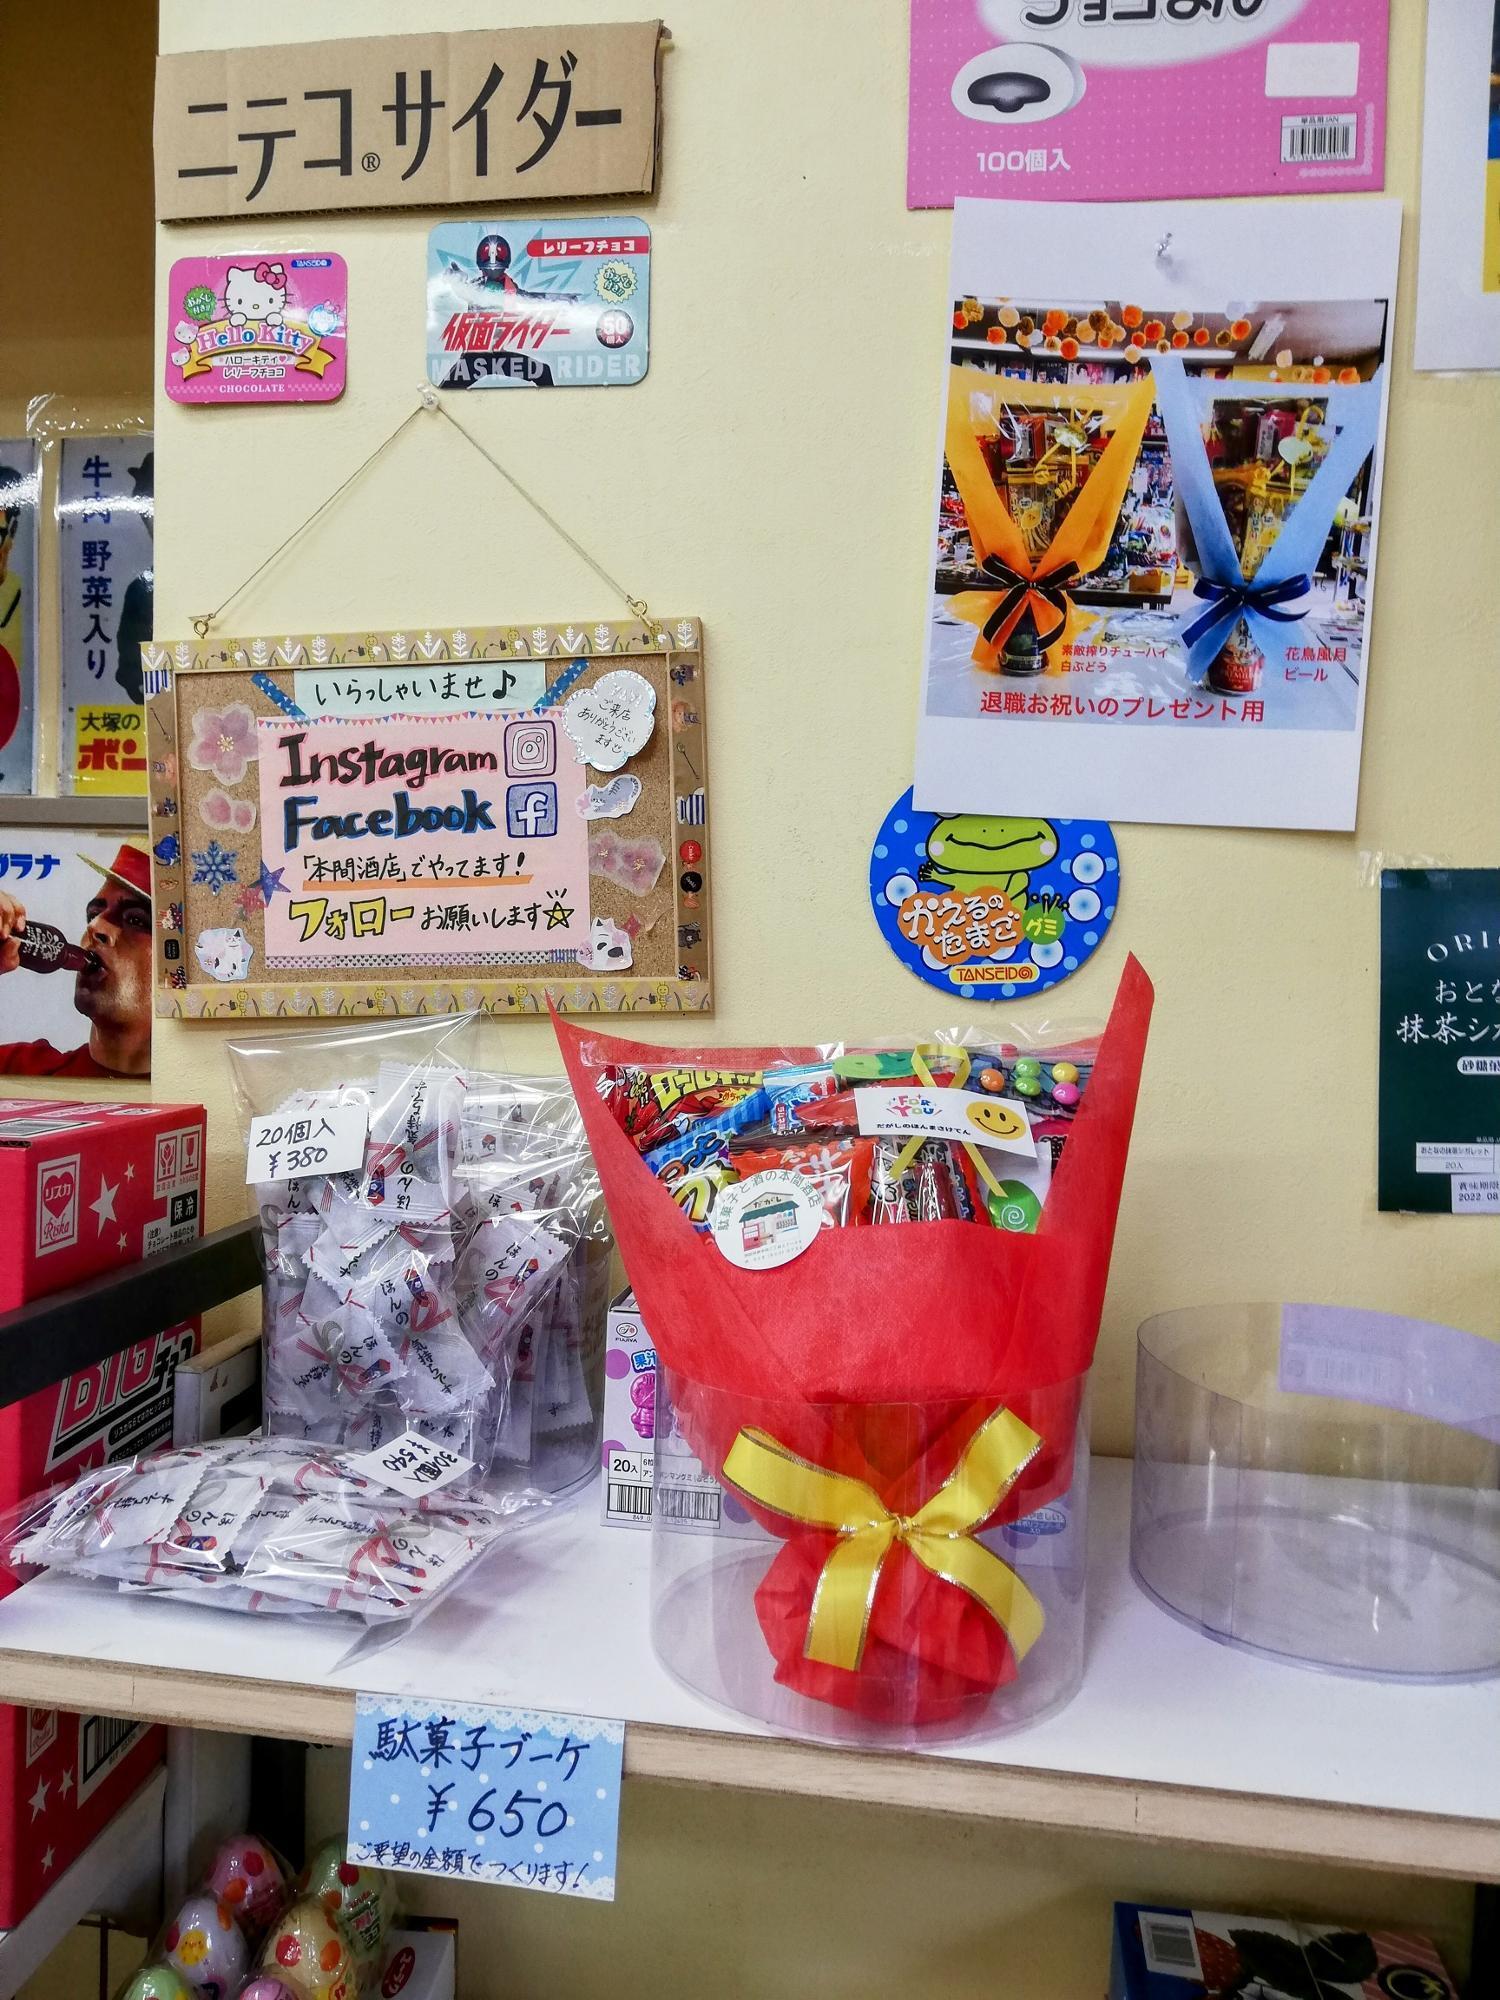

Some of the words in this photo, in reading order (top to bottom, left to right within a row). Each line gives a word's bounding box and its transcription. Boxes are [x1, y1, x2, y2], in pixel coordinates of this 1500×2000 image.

[976, 149, 1071, 173] 100個入
[543, 240, 636, 255] レリーフチョコ
[440, 311, 571, 351] 仮面ライダー
[604, 316, 628, 334] 50
[199, 326, 255, 352] Hello
[259, 323, 313, 354] Kitty
[225, 355, 279, 365] ハローキティ
[431, 357, 546, 382] MASKED
[557, 353, 641, 379] RIDER
[225, 368, 285, 379] レリーフチョコ
[219, 384, 285, 393] CHOCOLATE
[1060, 660, 1107, 673] 白ぶどう
[1284, 646, 1346, 662] 花鳥風月
[1284, 667, 1328, 681] ビール
[979, 691, 1265, 722] 退職お祝いのプレゼント用
[81, 713, 141, 732] 大塚の
[277, 732, 499, 788] Instagram
[283, 787, 495, 852] Facebook
[288, 896, 416, 941] フォロー
[420, 903, 544, 931] お願いします
[903, 894, 1004, 939] かえるの
[1025, 917, 1058, 938] グミ
[933, 911, 1020, 960] たまご
[1427, 930, 1500, 963] ORI
[892, 1102, 935, 1118] YOU
[897, 1095, 931, 1106] FOR
[256, 1117, 336, 1147] 20個入
[876, 1123, 971, 1136] だがしのほんまさけてん
[268, 1146, 328, 1178] ¥380
[174, 1195, 194, 1221] 保冷
[613, 1459, 639, 1475] 20入
[369, 1716, 590, 1782] 駄菓子ブーケ
[427, 1782, 568, 1838] ¥650
